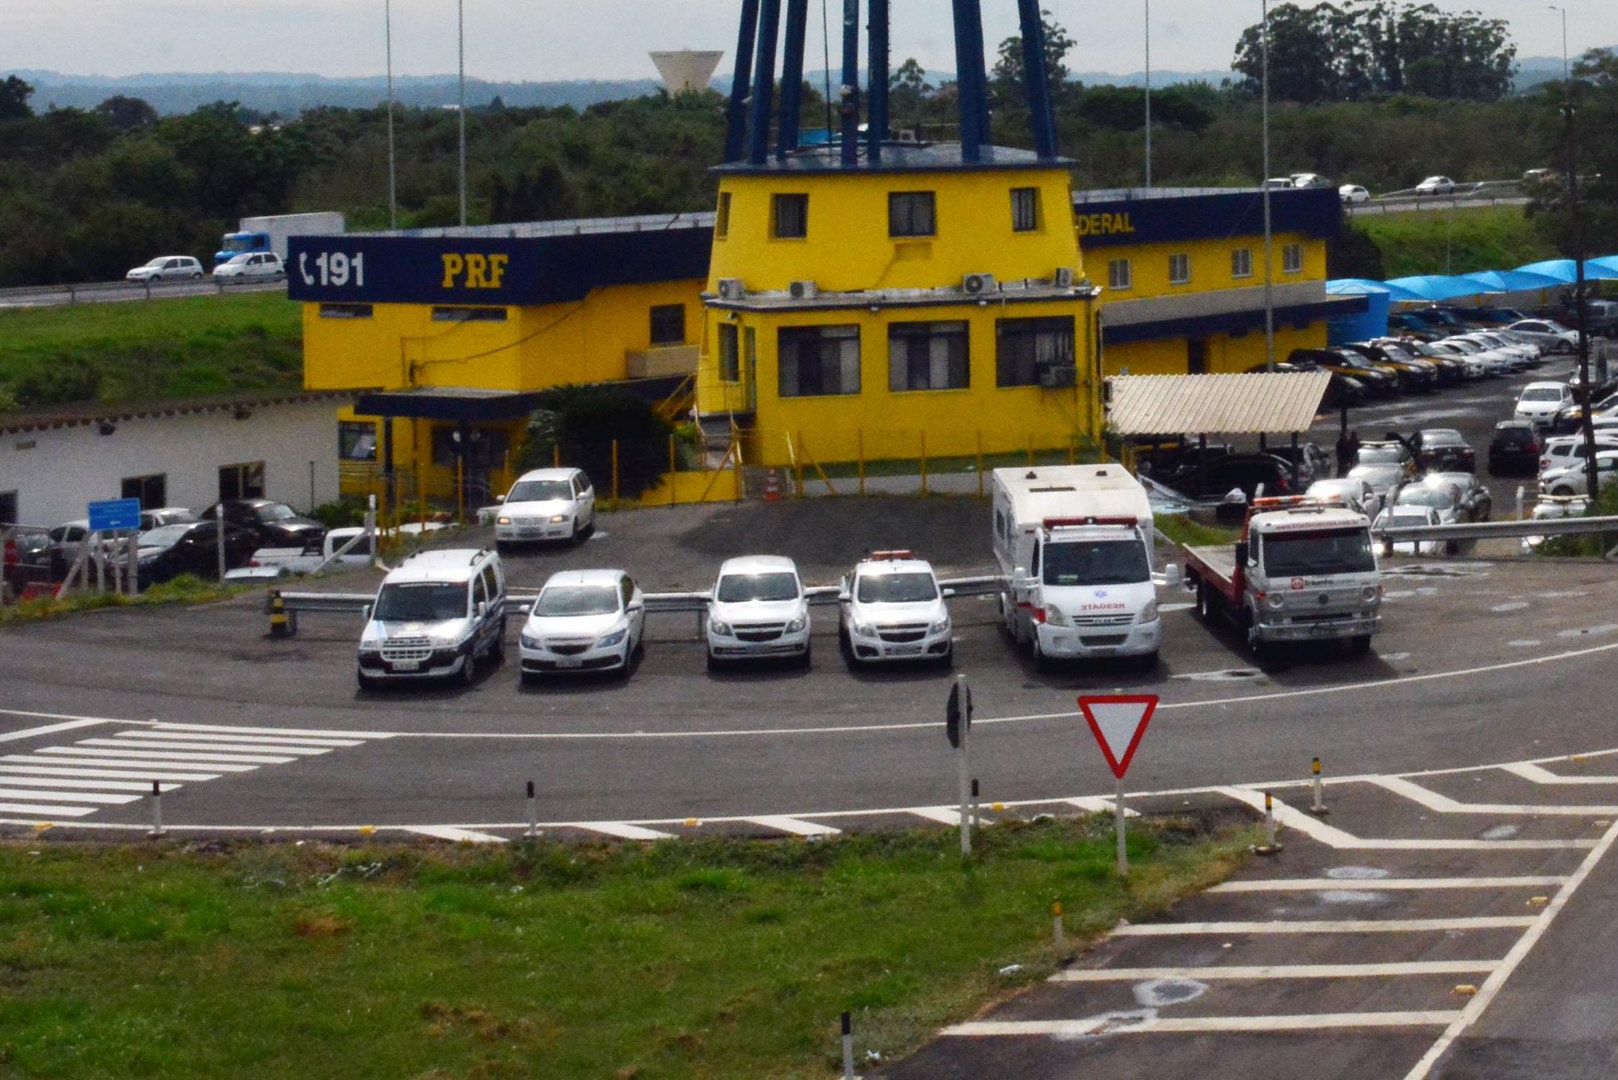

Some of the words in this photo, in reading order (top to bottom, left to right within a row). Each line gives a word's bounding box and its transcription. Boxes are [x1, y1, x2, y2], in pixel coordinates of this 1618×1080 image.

[1075, 212, 1136, 236] DERAL
[316, 252, 364, 286] 191
[441, 253, 509, 289] PRF
